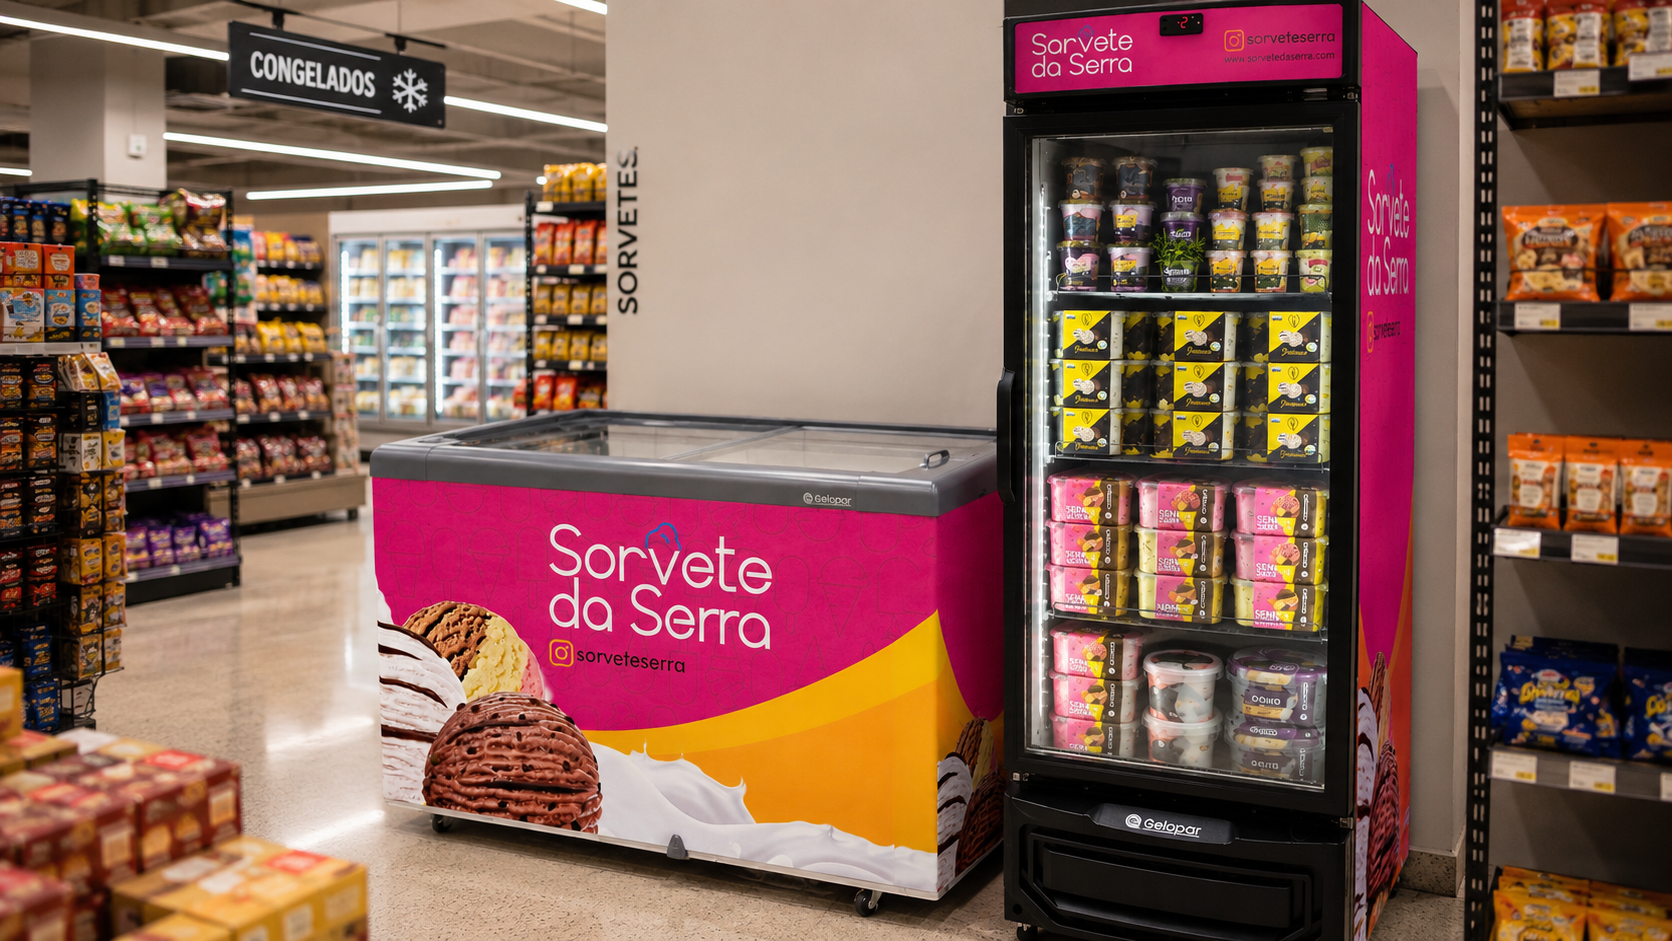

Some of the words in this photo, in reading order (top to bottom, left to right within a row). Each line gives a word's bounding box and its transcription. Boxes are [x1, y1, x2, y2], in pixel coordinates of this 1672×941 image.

[1031, 28, 1134, 56] Sorvete
[1247, 32, 1335, 45] sorveteserra
[250, 50, 376, 98] CONGELADOS
[1031, 56, 1061, 78] da
[1069, 52, 1133, 76] Serra
[1367, 169, 1410, 238] Sorvete
[1367, 235, 1381, 297] da
[1383, 236, 1410, 295] Serra
[814, 494, 852, 506] Gelopar
[549, 523, 773, 594] Sorvete
[549, 577, 613, 632] da
[630, 583, 771, 650] Serra
[577, 648, 686, 673] sorveteserra
[1144, 818, 1202, 836] Gelopar
